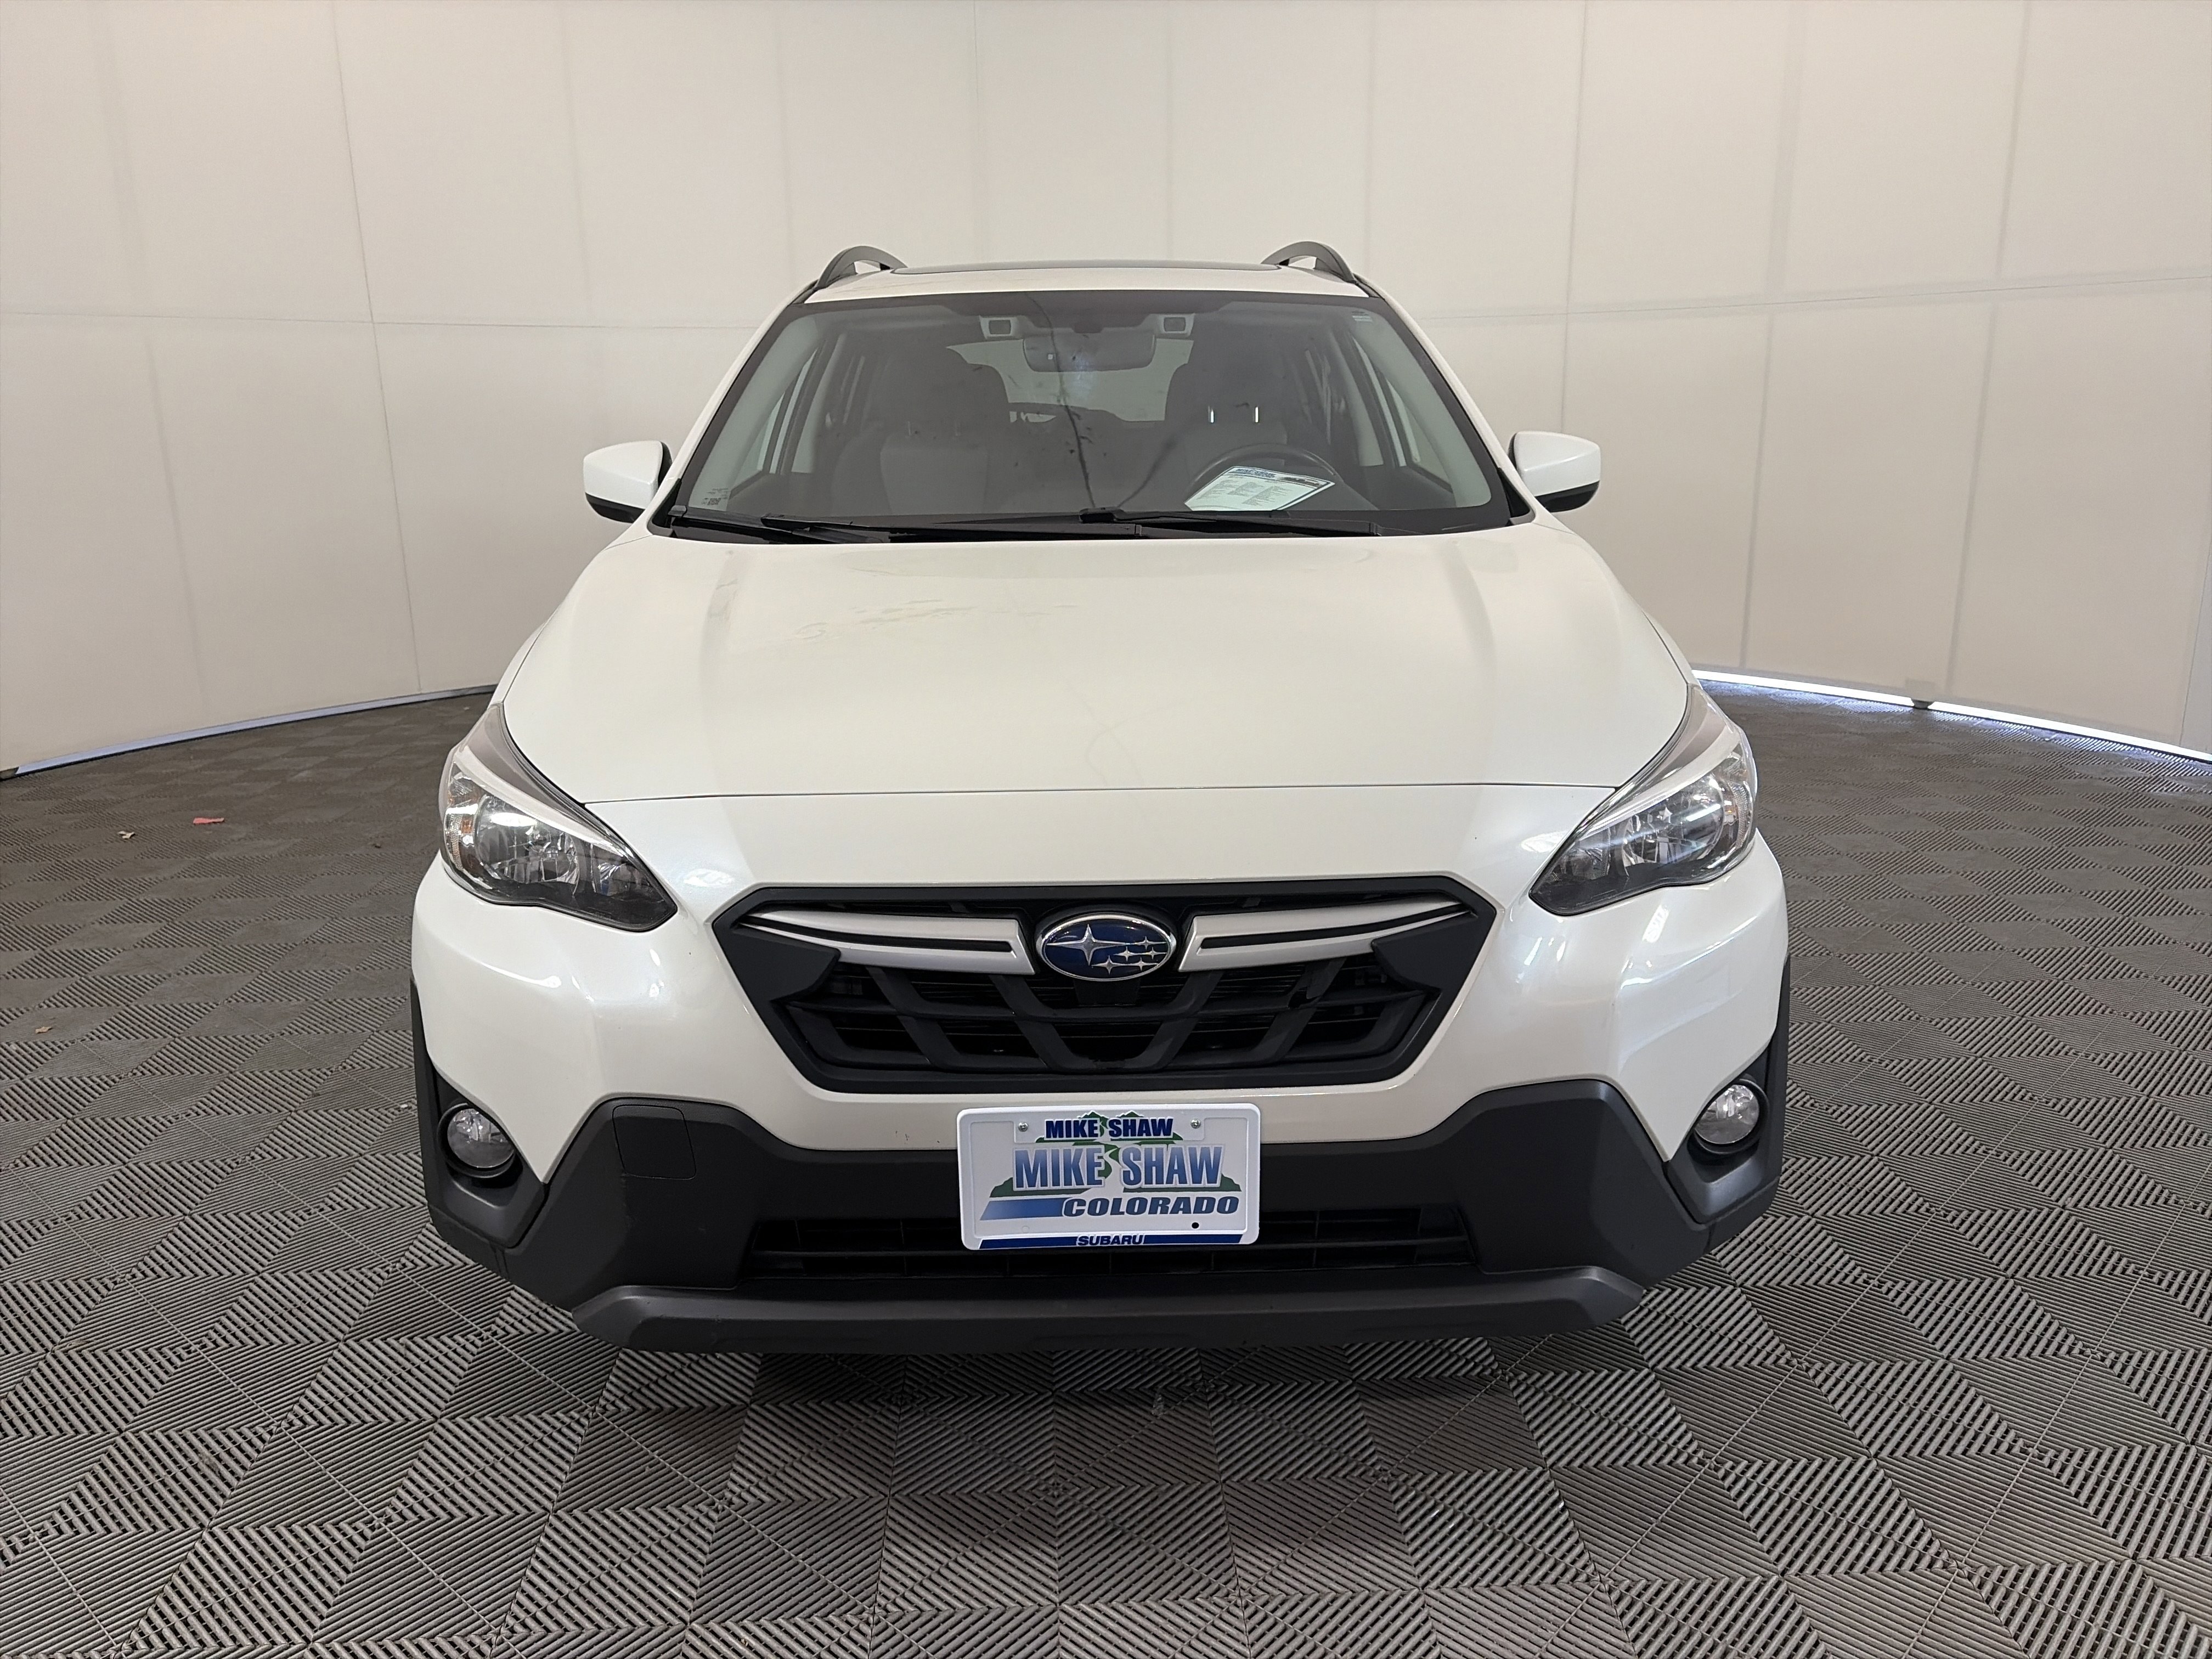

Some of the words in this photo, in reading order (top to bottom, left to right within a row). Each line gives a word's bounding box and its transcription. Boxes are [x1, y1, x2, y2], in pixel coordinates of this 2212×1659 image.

[1046, 1119, 1099, 1138] MIKE
[1109, 1118, 1173, 1137] SHAW
[1015, 1148, 1104, 1188] MIKE
[1121, 1146, 1222, 1187] SHAW
[1062, 1196, 1239, 1217] COLORADO
[1077, 1234, 1144, 1246] SUBARU
